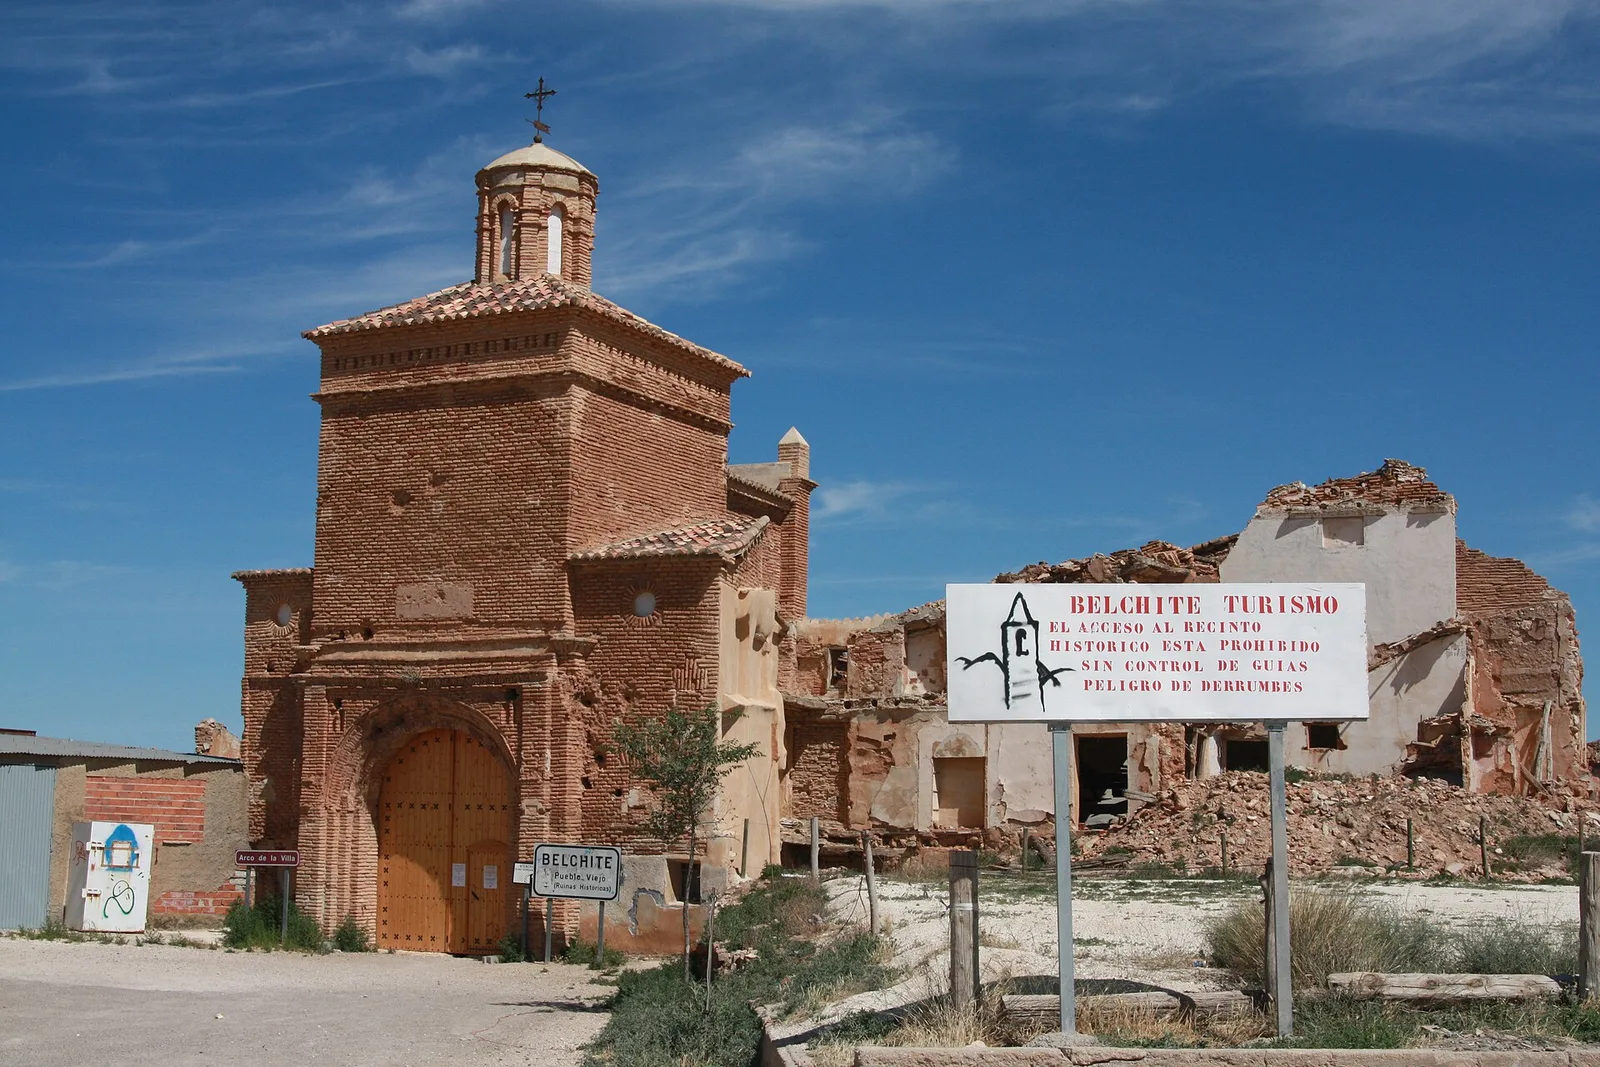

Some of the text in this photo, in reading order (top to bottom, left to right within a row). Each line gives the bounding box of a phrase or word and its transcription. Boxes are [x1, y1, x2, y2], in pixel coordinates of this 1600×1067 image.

[1070, 595, 1339, 615] BELCHITE TURISMO
[1049, 620, 1262, 634] EL ACCESO AL RECINTO
[1049, 639, 1321, 653] HISTORICO ESTA PROHIBIDO
[1081, 659, 1309, 673] SIN CONTROL DE GUIAS
[1083, 679, 1304, 693] PELIGRO DE DERRUMBES
[542, 853, 613, 869] BELCHITE
[555, 872, 606, 883] Pueblo Viejo
